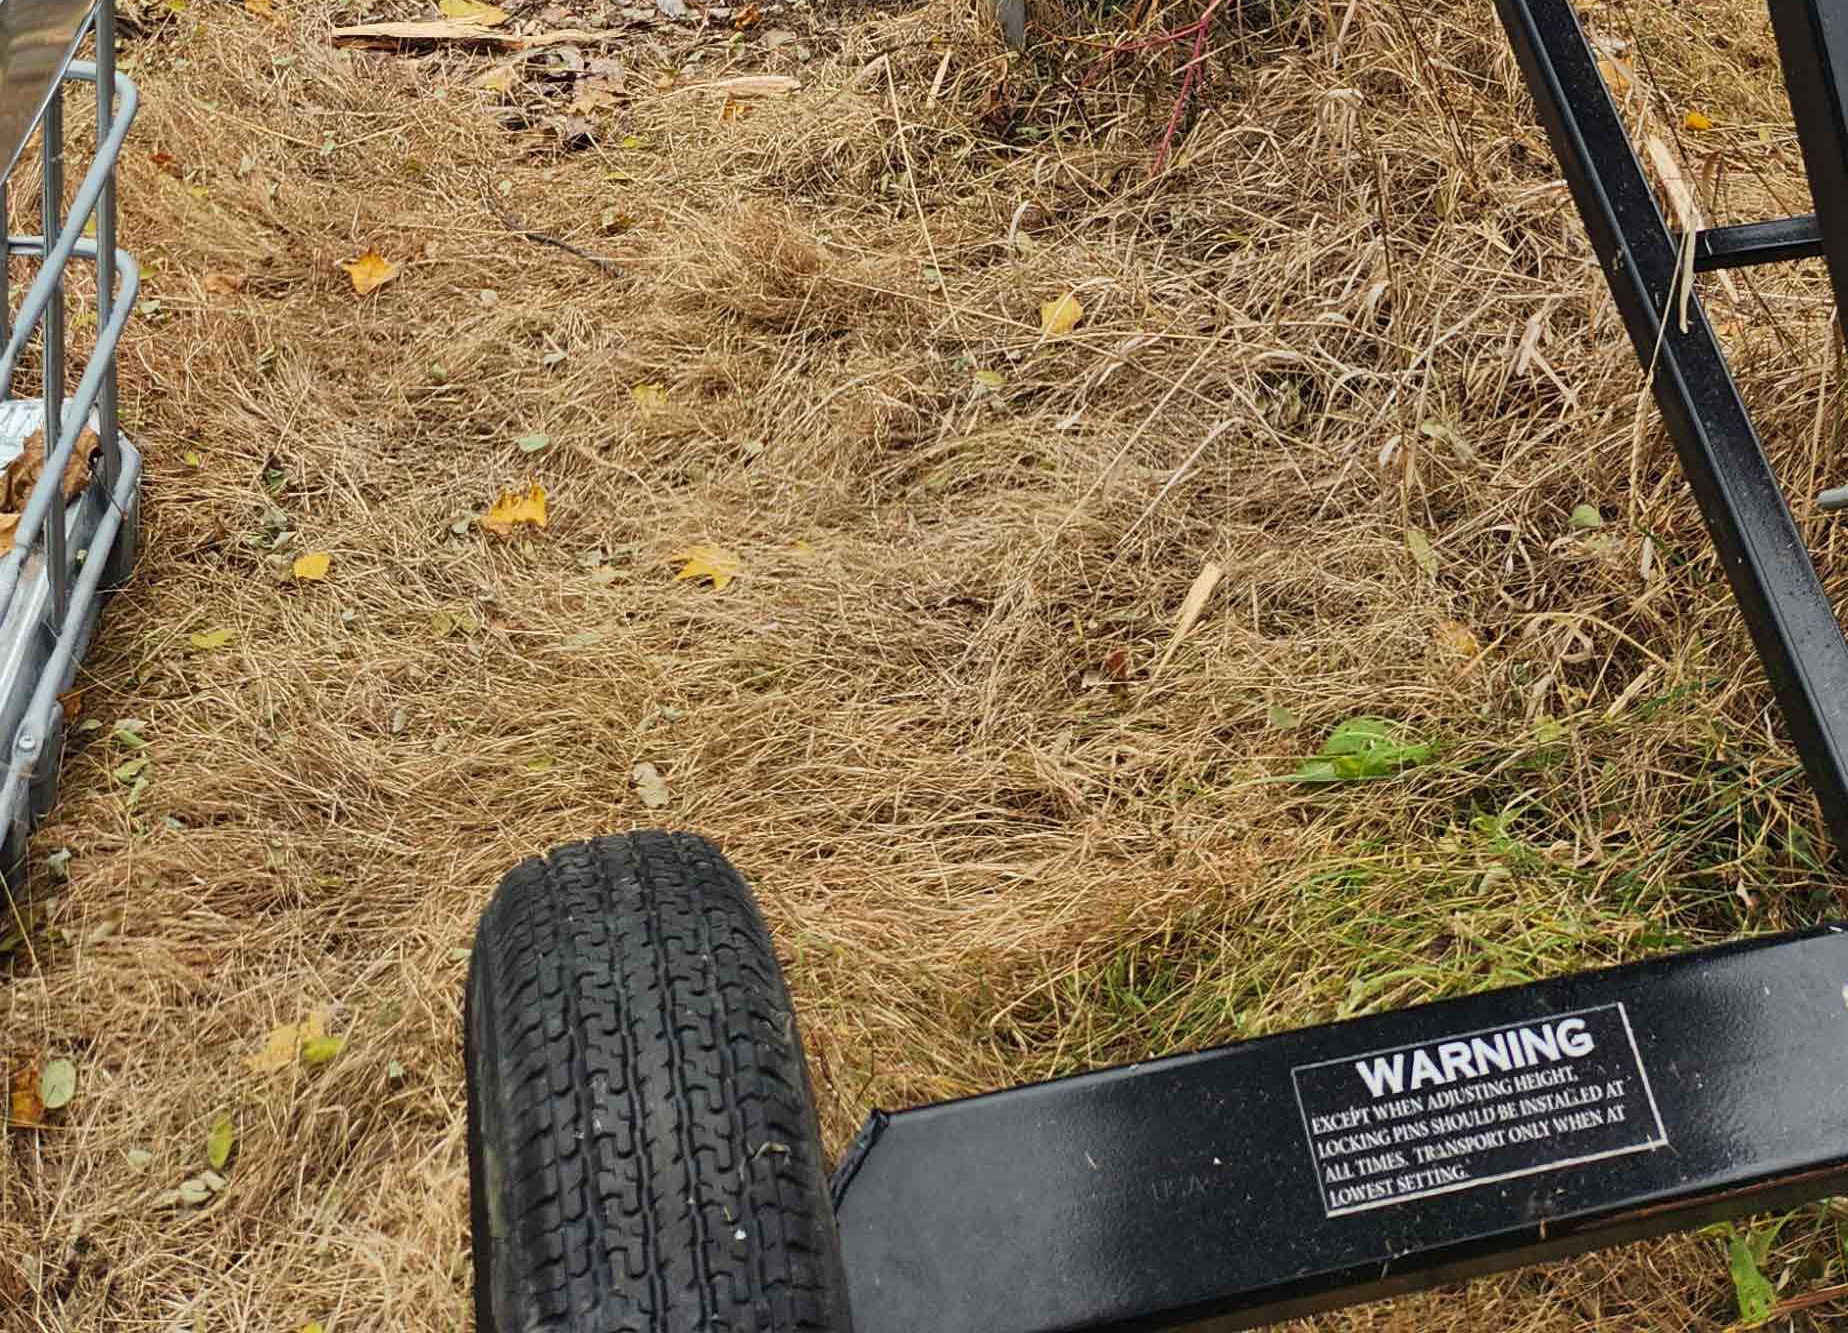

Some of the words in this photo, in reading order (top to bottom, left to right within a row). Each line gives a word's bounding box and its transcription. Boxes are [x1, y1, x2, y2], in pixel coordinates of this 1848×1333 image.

[1355, 1018, 1595, 1098] WARNING
[1311, 1107, 1370, 1135] EXCEPT
[1373, 1096, 1424, 1120] WHEN
[1427, 1078, 1513, 1111] ADJUSTING
[1317, 1128, 1391, 1160] LOCKING
[1393, 1119, 1429, 1143] PINS
[1430, 1107, 1496, 1135] SHOULD
[1497, 1100, 1519, 1119] BE
[1519, 1084, 1602, 1115] INSTALLED
[1606, 1080, 1625, 1098] AT
[1325, 1162, 1354, 1183] ALL
[1354, 1151, 1409, 1176] TIMES.
[1413, 1130, 1506, 1165] TRANSPORT
[1508, 1120, 1551, 1146] ONLY
[1552, 1109, 1604, 1133] WHEN
[1606, 1105, 1626, 1123] AT
[1328, 1179, 1395, 1208] LOWEST
[1397, 1163, 1470, 1193] SETTING.
